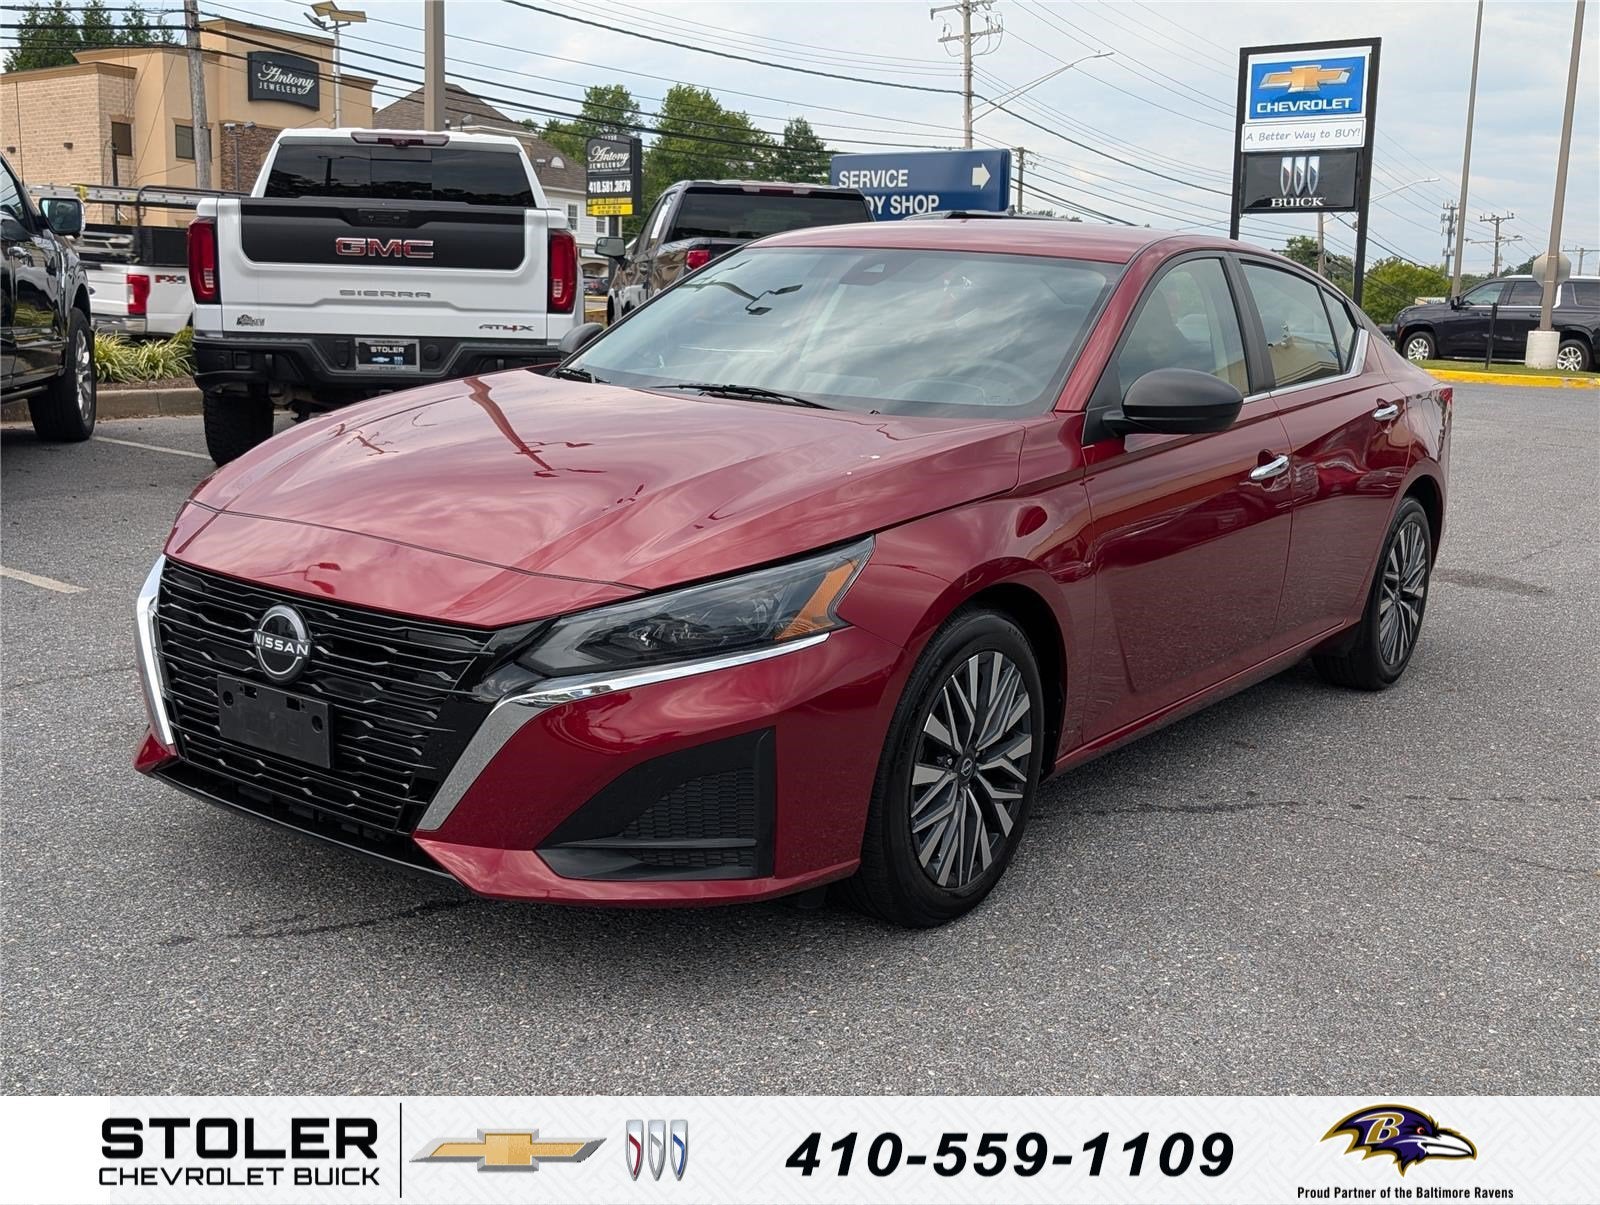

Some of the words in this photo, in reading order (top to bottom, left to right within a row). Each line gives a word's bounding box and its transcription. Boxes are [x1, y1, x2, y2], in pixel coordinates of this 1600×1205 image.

[257, 61, 314, 95] Antony
[258, 82, 303, 95] JEWELERS
[1256, 97, 1353, 114] CHEVROLET
[1245, 132, 1254, 143] A
[1258, 130, 1291, 142] Better
[1294, 129, 1316, 142] Way
[1320, 130, 1331, 140] to
[1335, 128, 1361, 139] BUY!
[587, 145, 631, 167] Antony
[589, 161, 621, 170] JEWELERS
[838, 169, 909, 189] SERVICE
[889, 194, 940, 215] SHOP
[1270, 197, 1325, 208] BUICK
[336, 237, 434, 259] GMC
[339, 289, 432, 298] SIERRA
[478, 323, 535, 333] AT4X
[370, 345, 405, 354] STOLER
[253, 631, 309, 656] NISSAN
